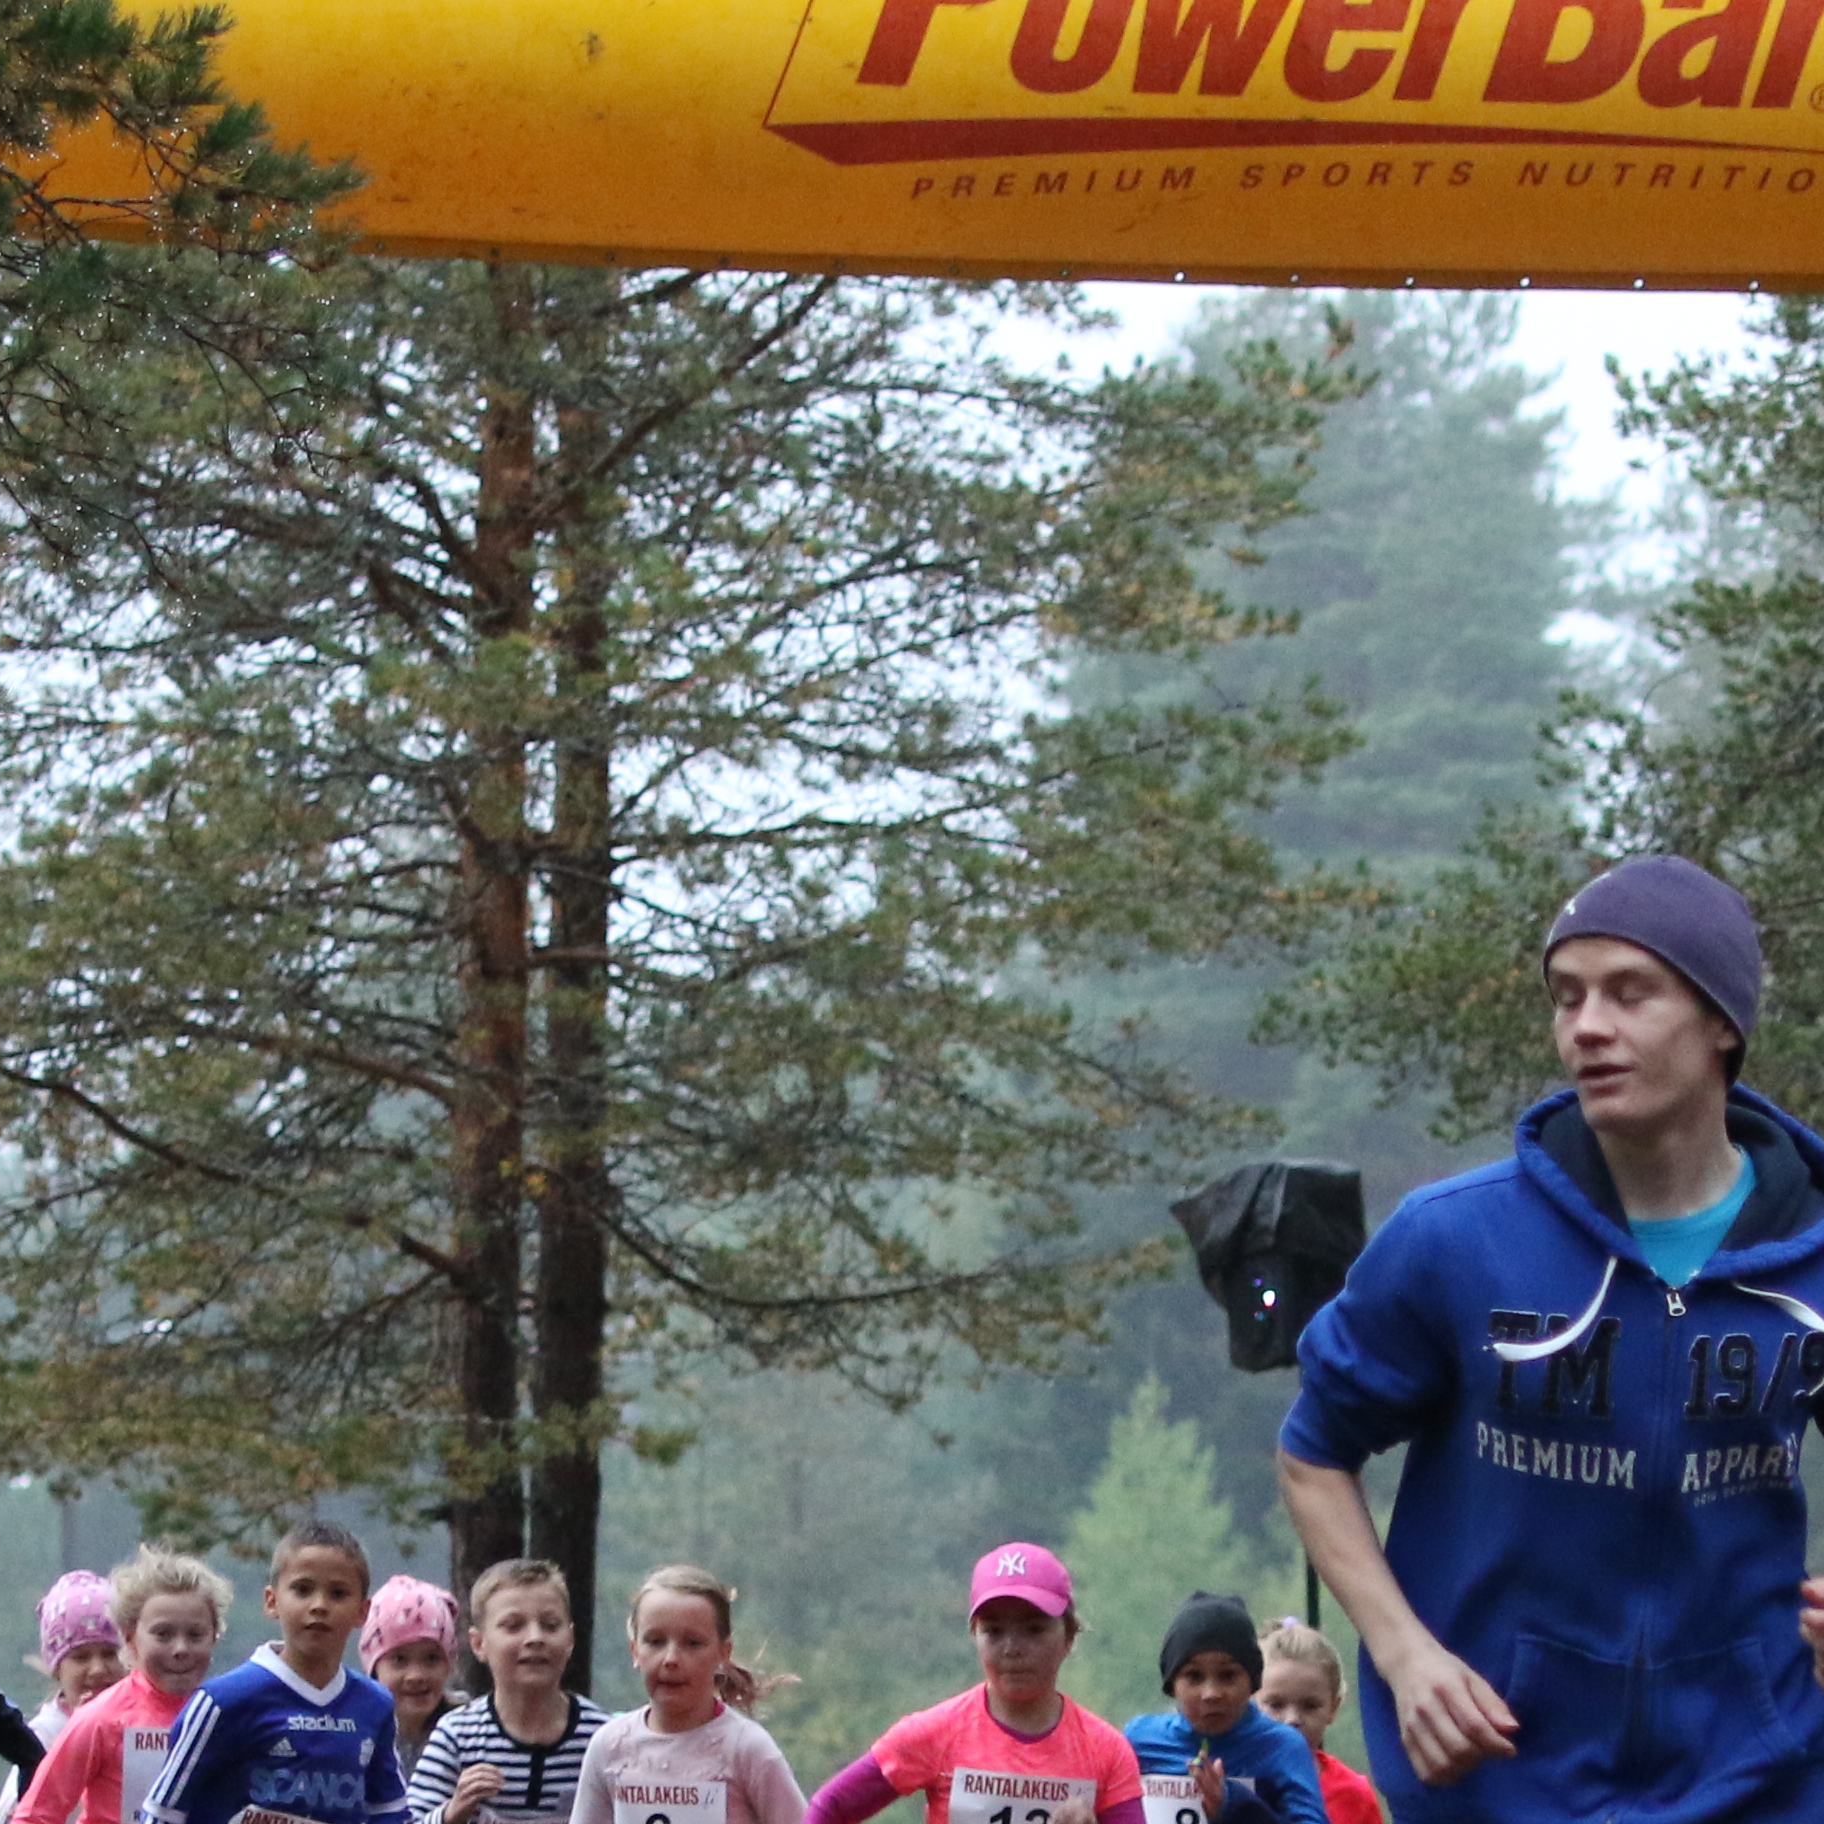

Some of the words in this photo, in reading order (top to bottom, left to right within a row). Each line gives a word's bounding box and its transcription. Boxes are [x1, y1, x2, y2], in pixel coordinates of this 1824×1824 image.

[910, 165, 1196, 199] PREMIUM
[1239, 161, 1476, 190] SPORTS
[1477, 1420, 1637, 1490] PREMIUM
[287, 1714, 357, 1733] stadium
[964, 1774, 1070, 1801] RANTALAKEUS
